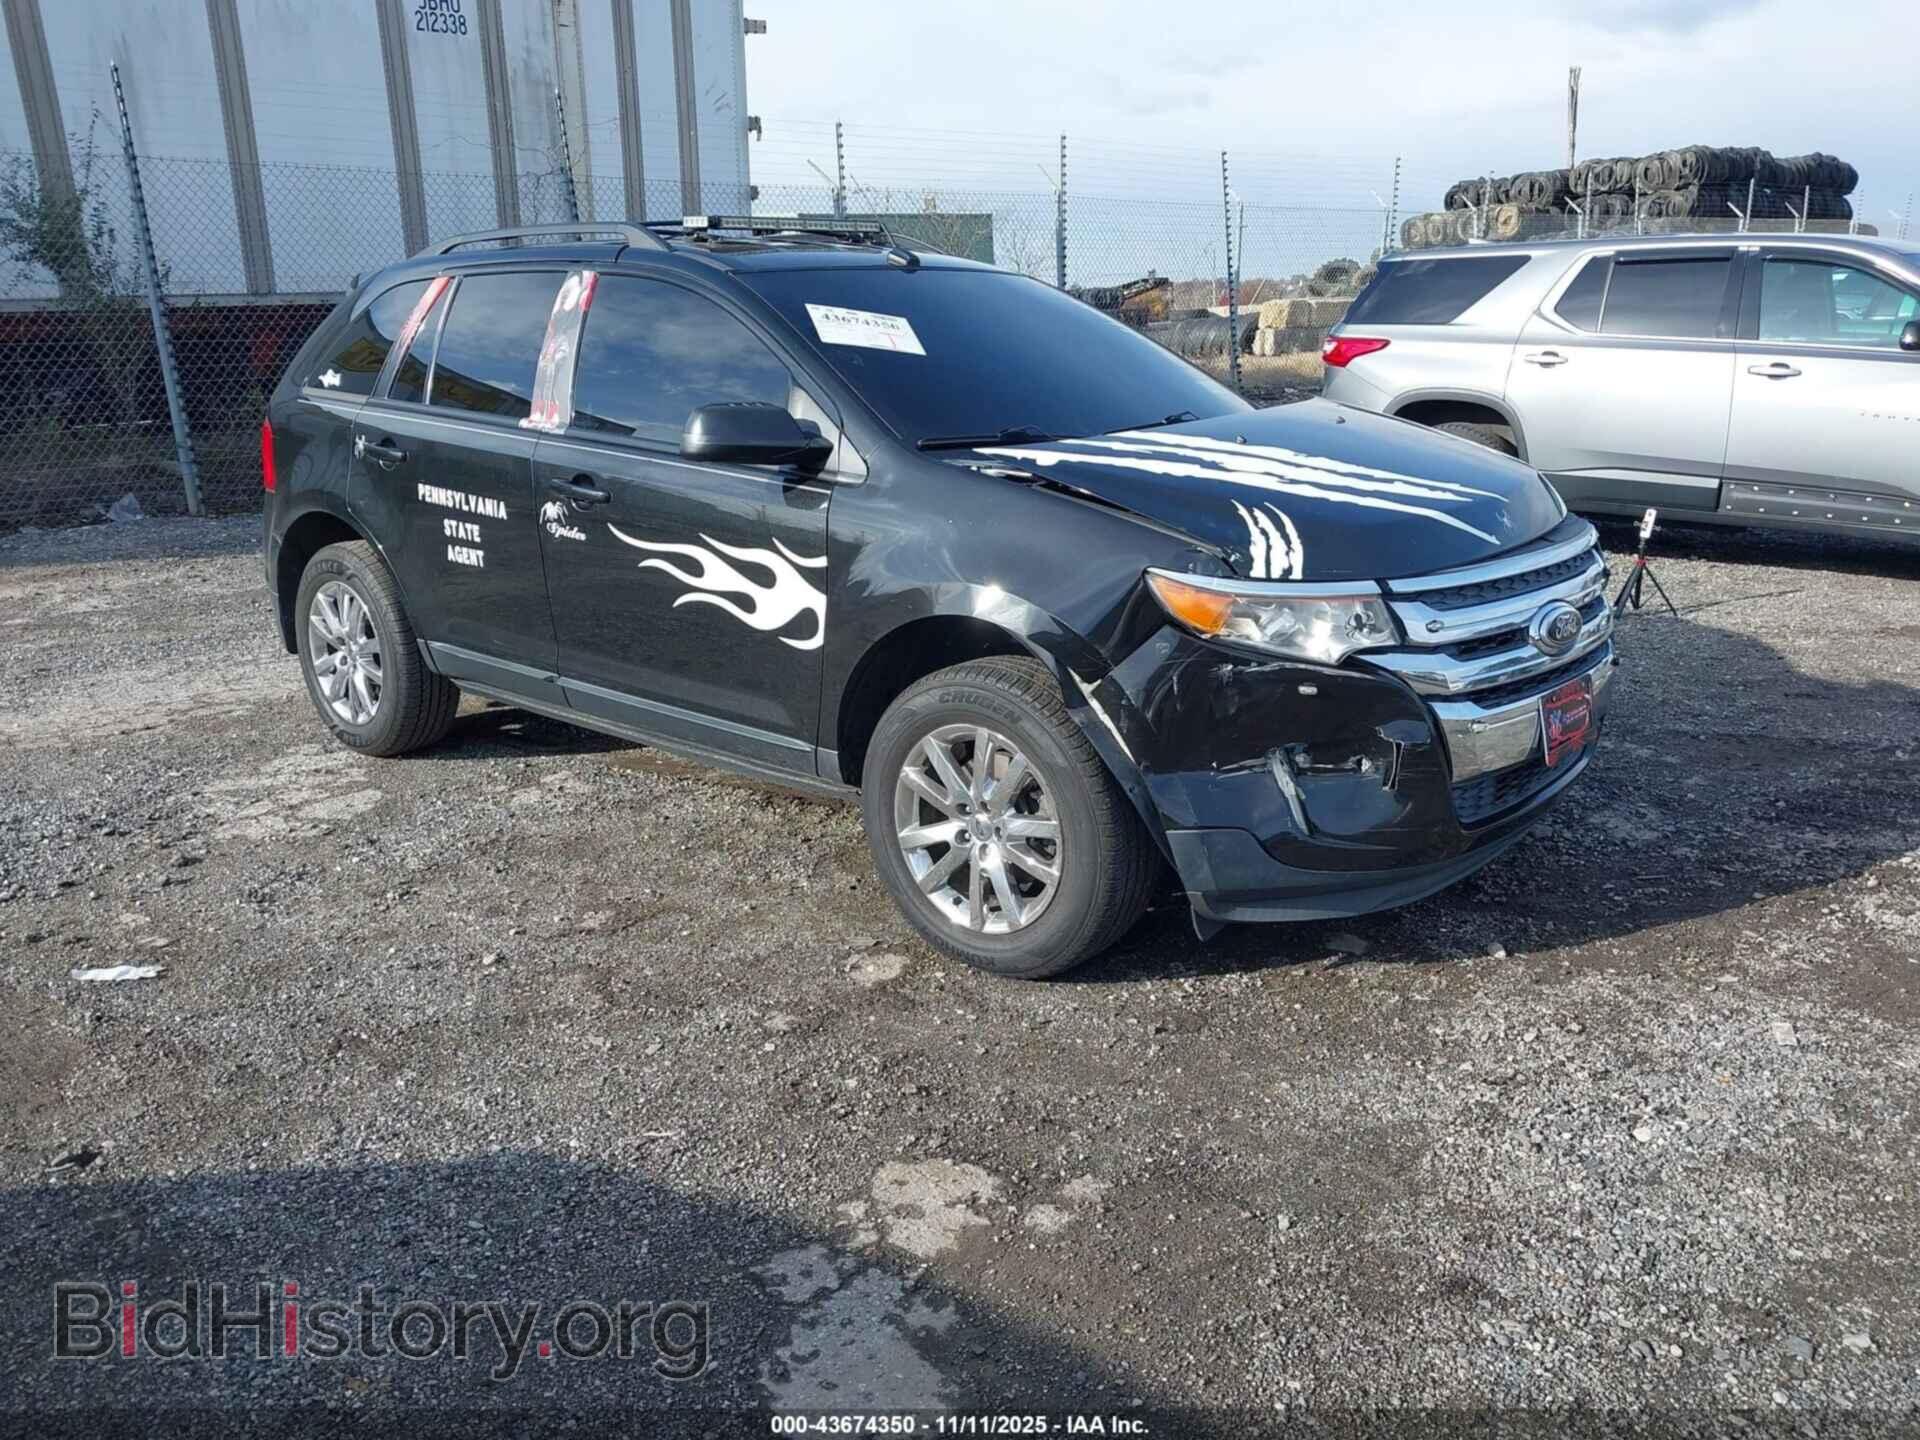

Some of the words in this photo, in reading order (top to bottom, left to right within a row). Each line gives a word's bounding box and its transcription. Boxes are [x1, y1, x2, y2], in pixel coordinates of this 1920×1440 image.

[414, 10, 467, 35] 212338
[417, 482, 508, 521] PENNSYLVANIA
[443, 518, 482, 543] STATE
[447, 544, 485, 568] AGENT
